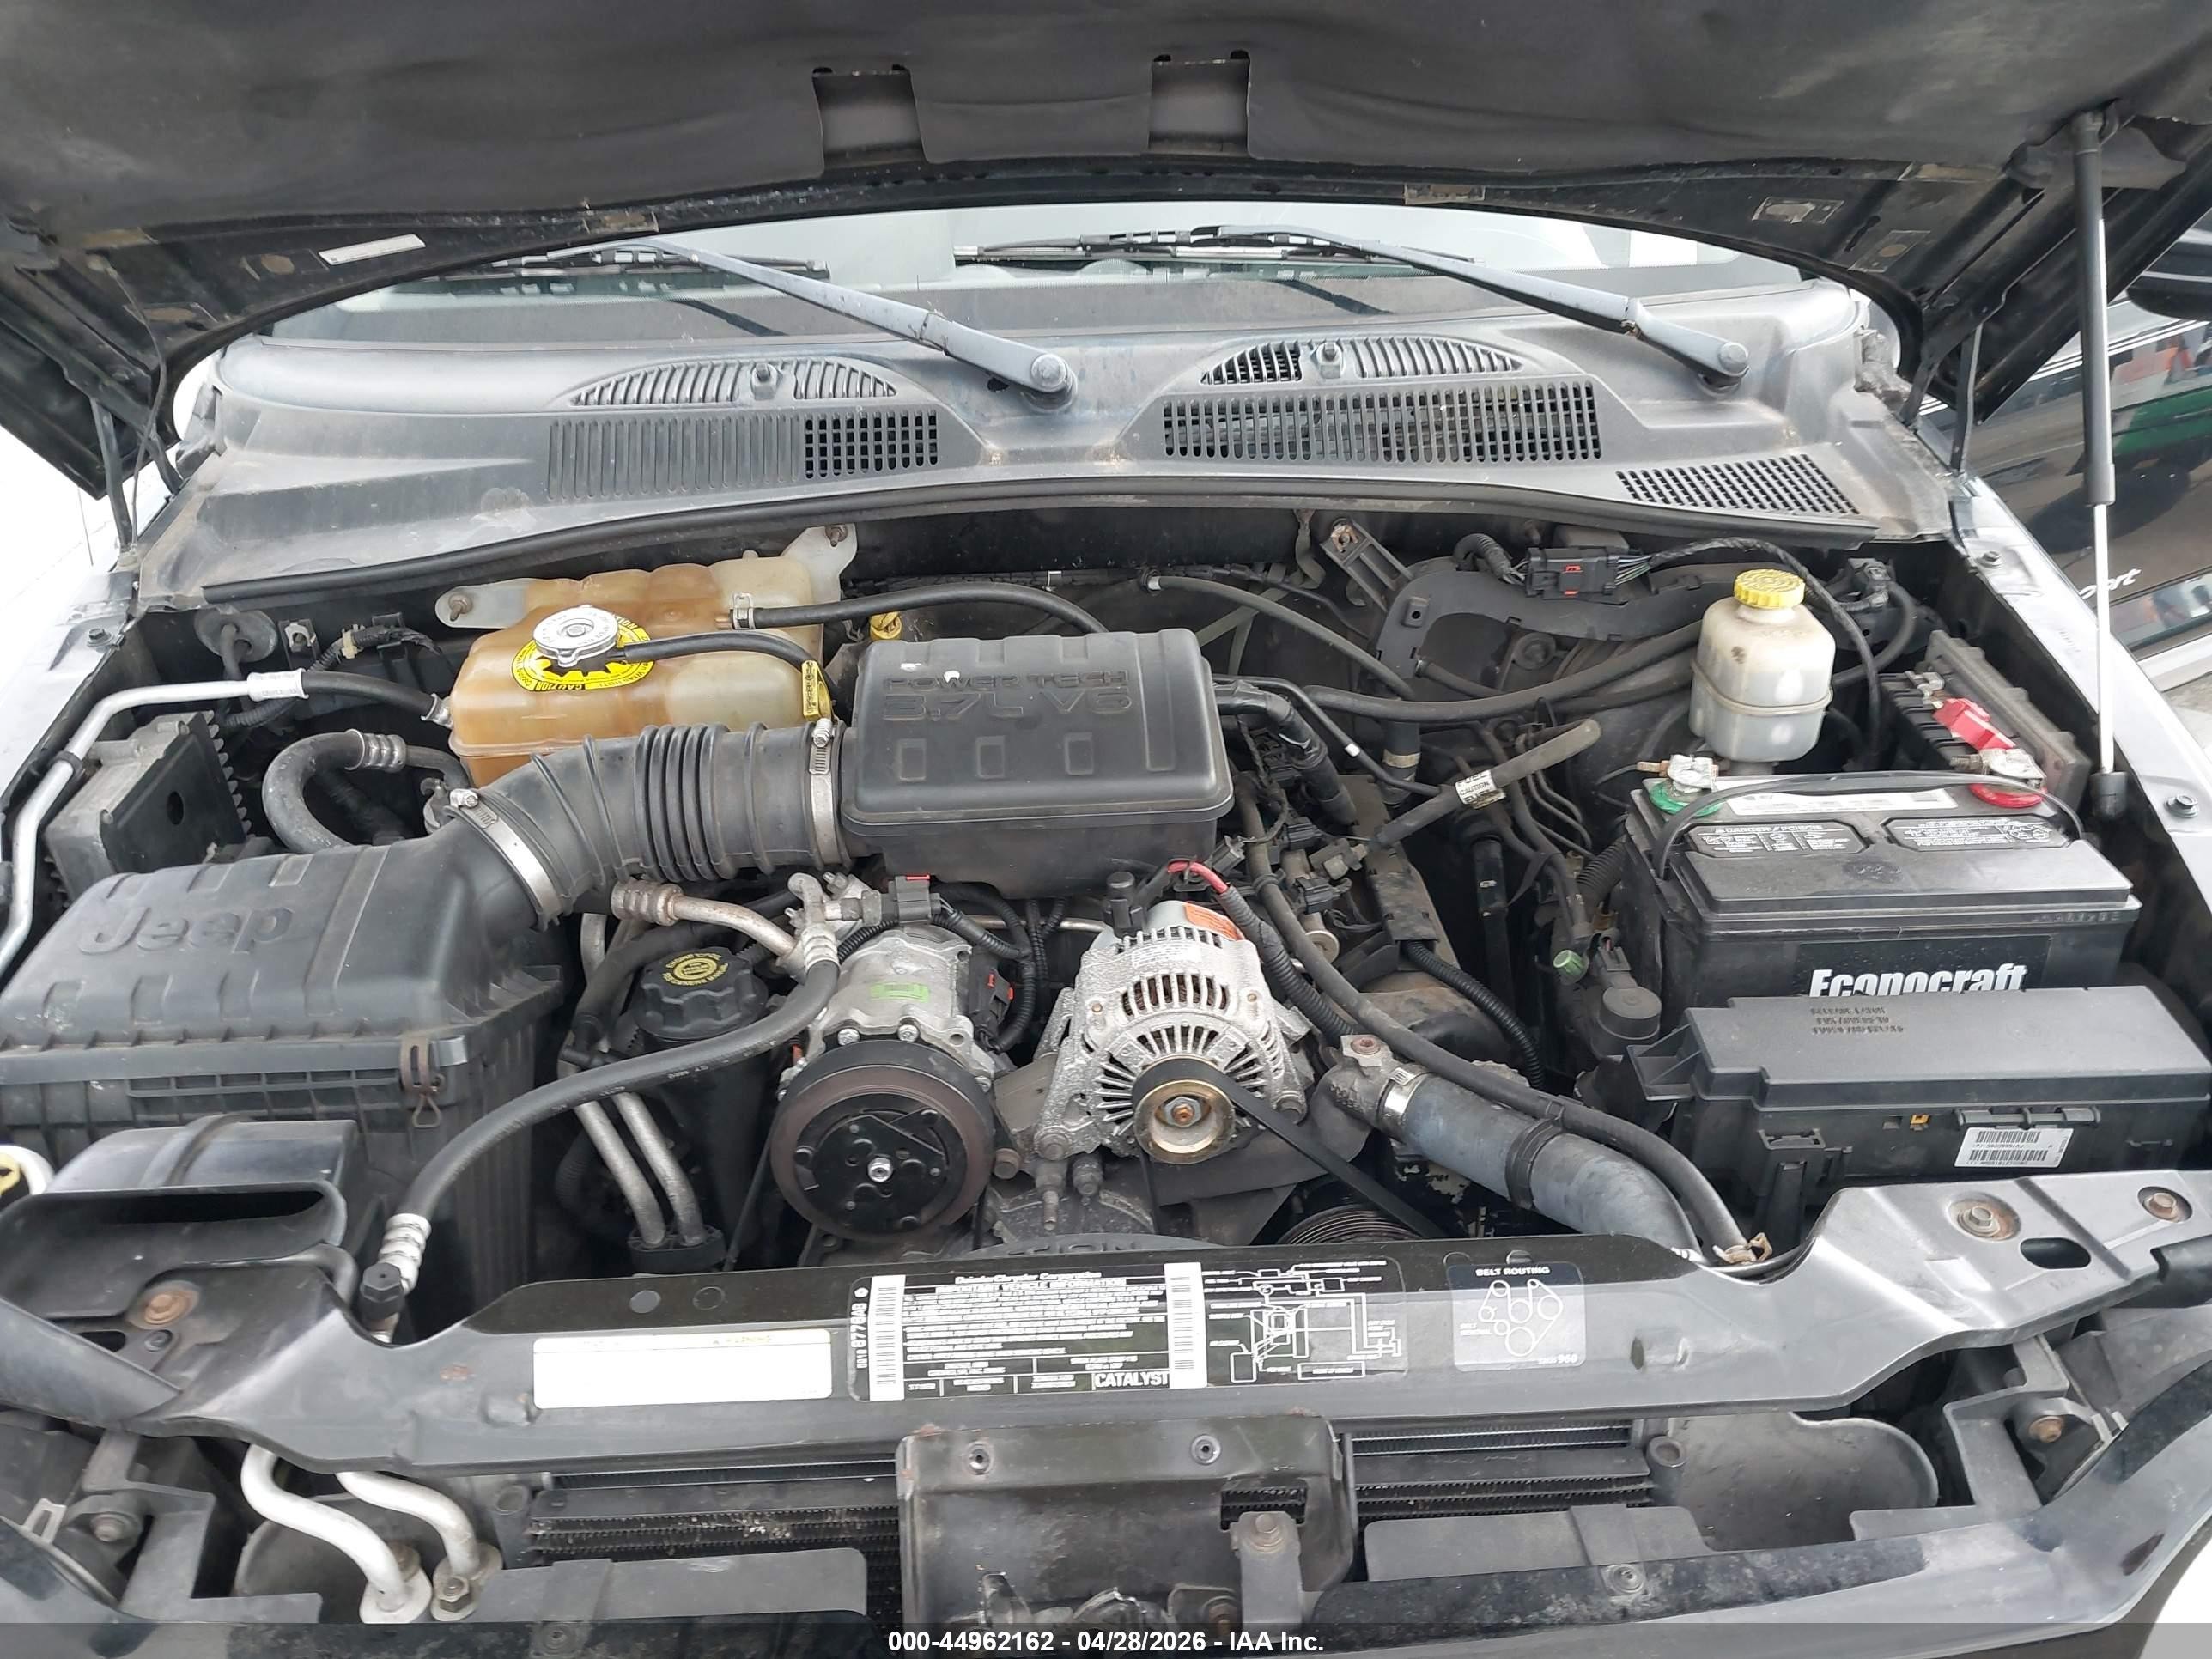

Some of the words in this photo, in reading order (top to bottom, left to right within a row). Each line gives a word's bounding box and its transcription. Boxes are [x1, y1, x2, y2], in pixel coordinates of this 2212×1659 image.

[536, 681, 584, 691] CAUTION
[885, 673, 1020, 691] POWER
[1027, 670, 1129, 688] TECH
[883, 691, 1024, 720] 3.7L
[1039, 688, 1133, 714] V6
[78, 907, 295, 956] Jeep
[1808, 963, 2028, 998] Econocraft
[1475, 1268, 1501, 1277] BELT
[1504, 1267, 1550, 1276] ROUTING
[1095, 1372, 1168, 1388] CATALYST
